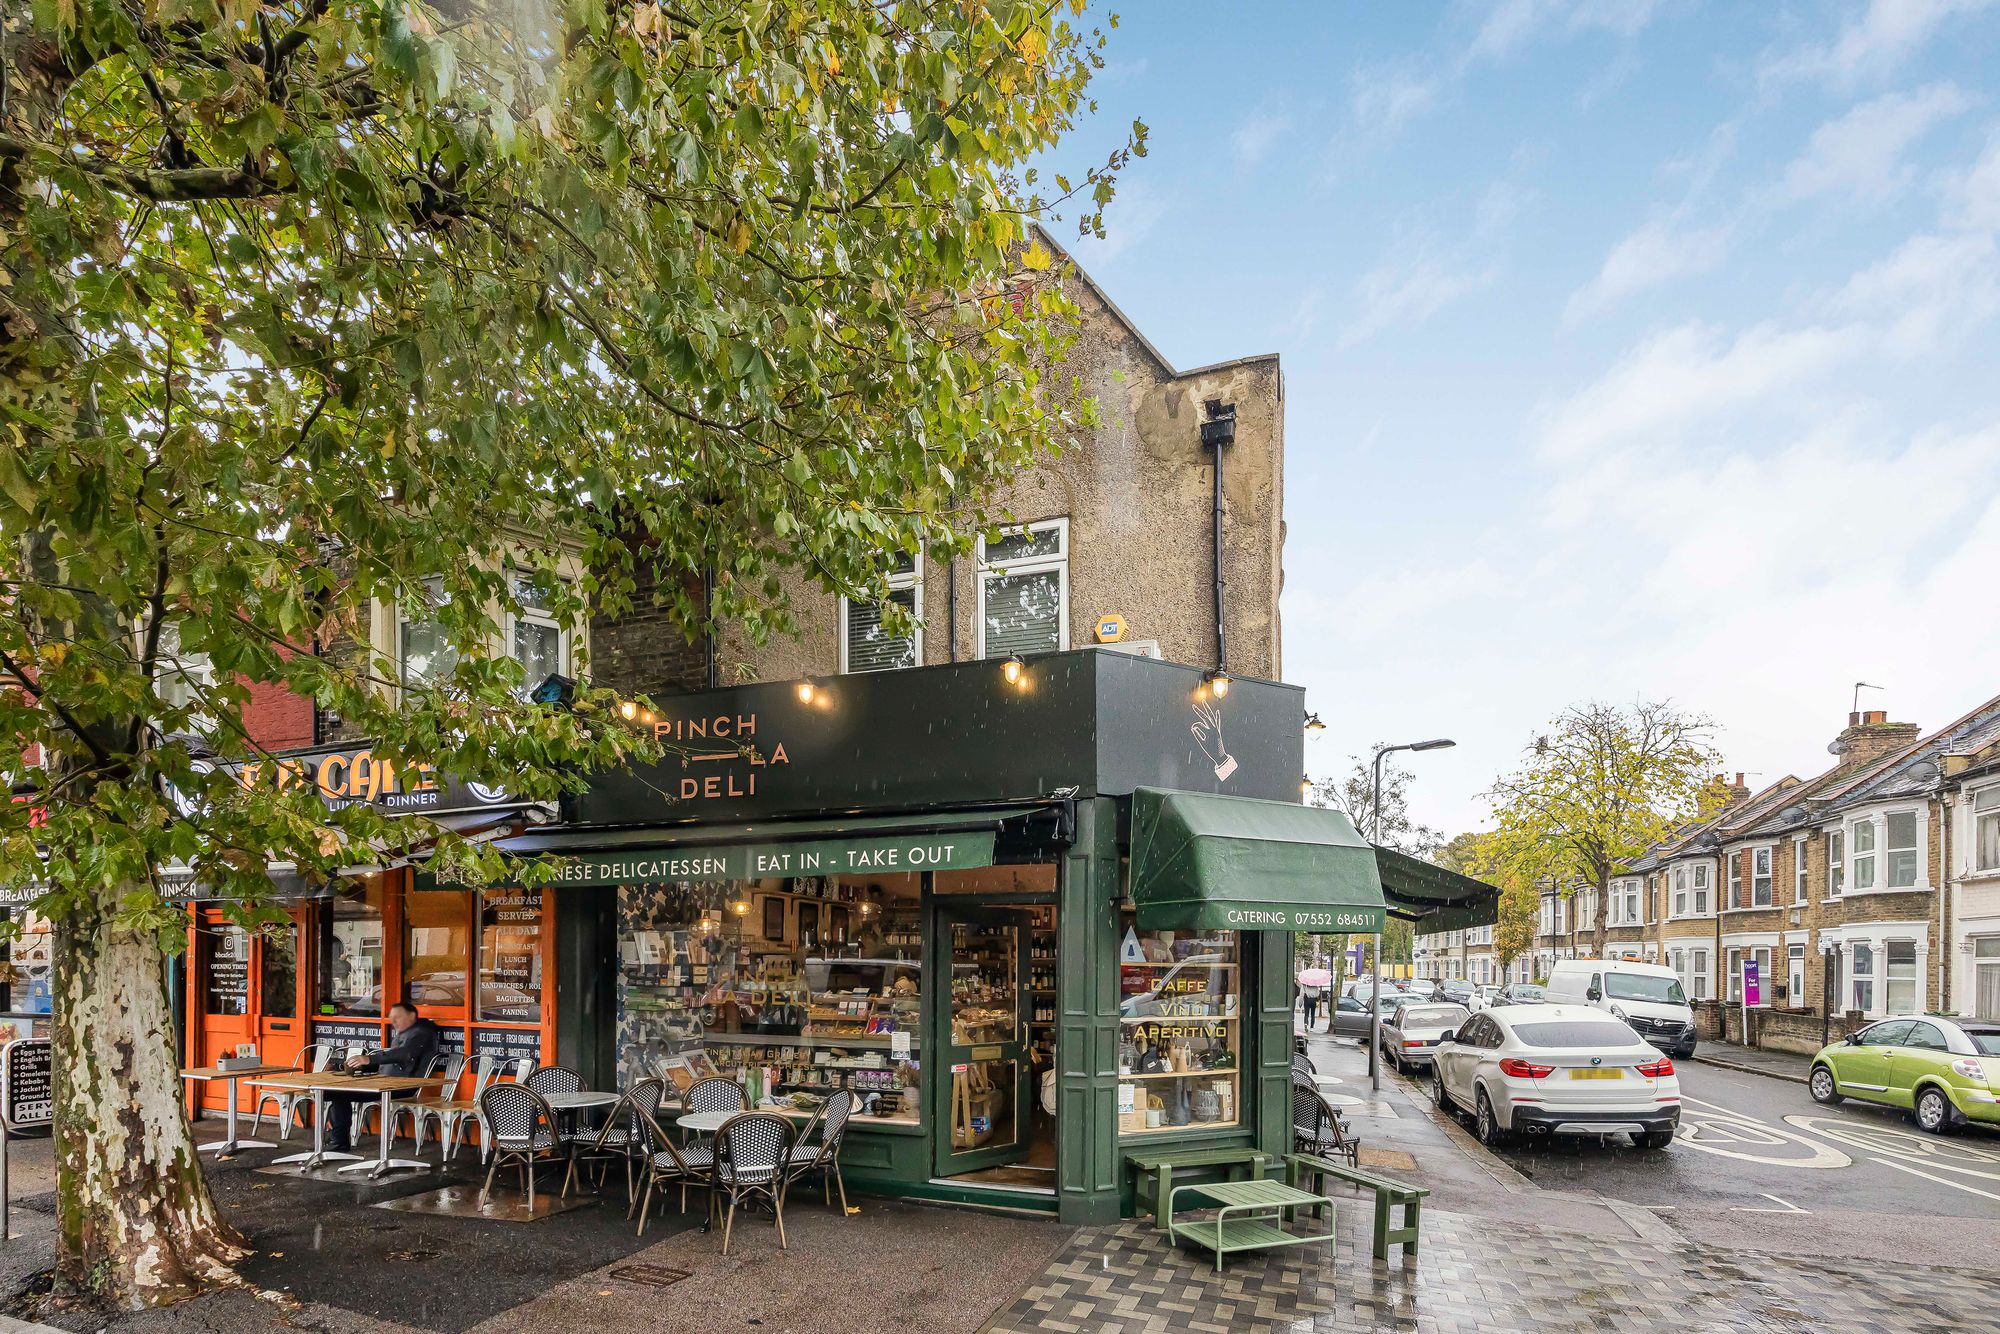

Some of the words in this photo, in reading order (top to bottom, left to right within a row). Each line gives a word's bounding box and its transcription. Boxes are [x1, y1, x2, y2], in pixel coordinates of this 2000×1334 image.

[1102, 624, 1117, 633] ADT
[654, 713, 756, 741] PINCH
[750, 742, 790, 765] LA
[681, 773, 755, 799] DELI
[387, 793, 437, 807] DINNER
[513, 865, 592, 882] JNESE
[600, 857, 727, 879] DELICATESSEN
[757, 854, 791, 871] EAT
[800, 852, 820, 869] IN
[847, 848, 898, 867] TAKE
[908, 845, 954, 865] OUT
[489, 895, 542, 907] BREAKFAST
[497, 911, 535, 921] SERVED
[1228, 910, 1286, 924] CATERING
[1295, 912, 1332, 925] 07552
[1337, 913, 1375, 926] 684511
[503, 969, 528, 977] DINNER
[481, 982, 524, 990] SANDWICHES
[496, 995, 535, 1003] BAGUETTES
[1160, 1003, 1203, 1017] VINO
[365, 1028, 381, 1037] CHOCOLA
[1134, 1025, 1227, 1039] APERITIVO
[486, 1033, 501, 1043] COFFEE
[517, 1035, 535, 1045] ORANGE
[479, 1046, 504, 1057] SANDWICHES
[508, 1048, 530, 1058] BAGUETTES
[20, 1056, 42, 1064] English
[700, 1058, 762, 1068] CARCUTERIE
[20, 1078, 44, 1086] Kebabs
[19, 1102, 52, 1111] SERV
[19, 1112, 41, 1120] ALL
